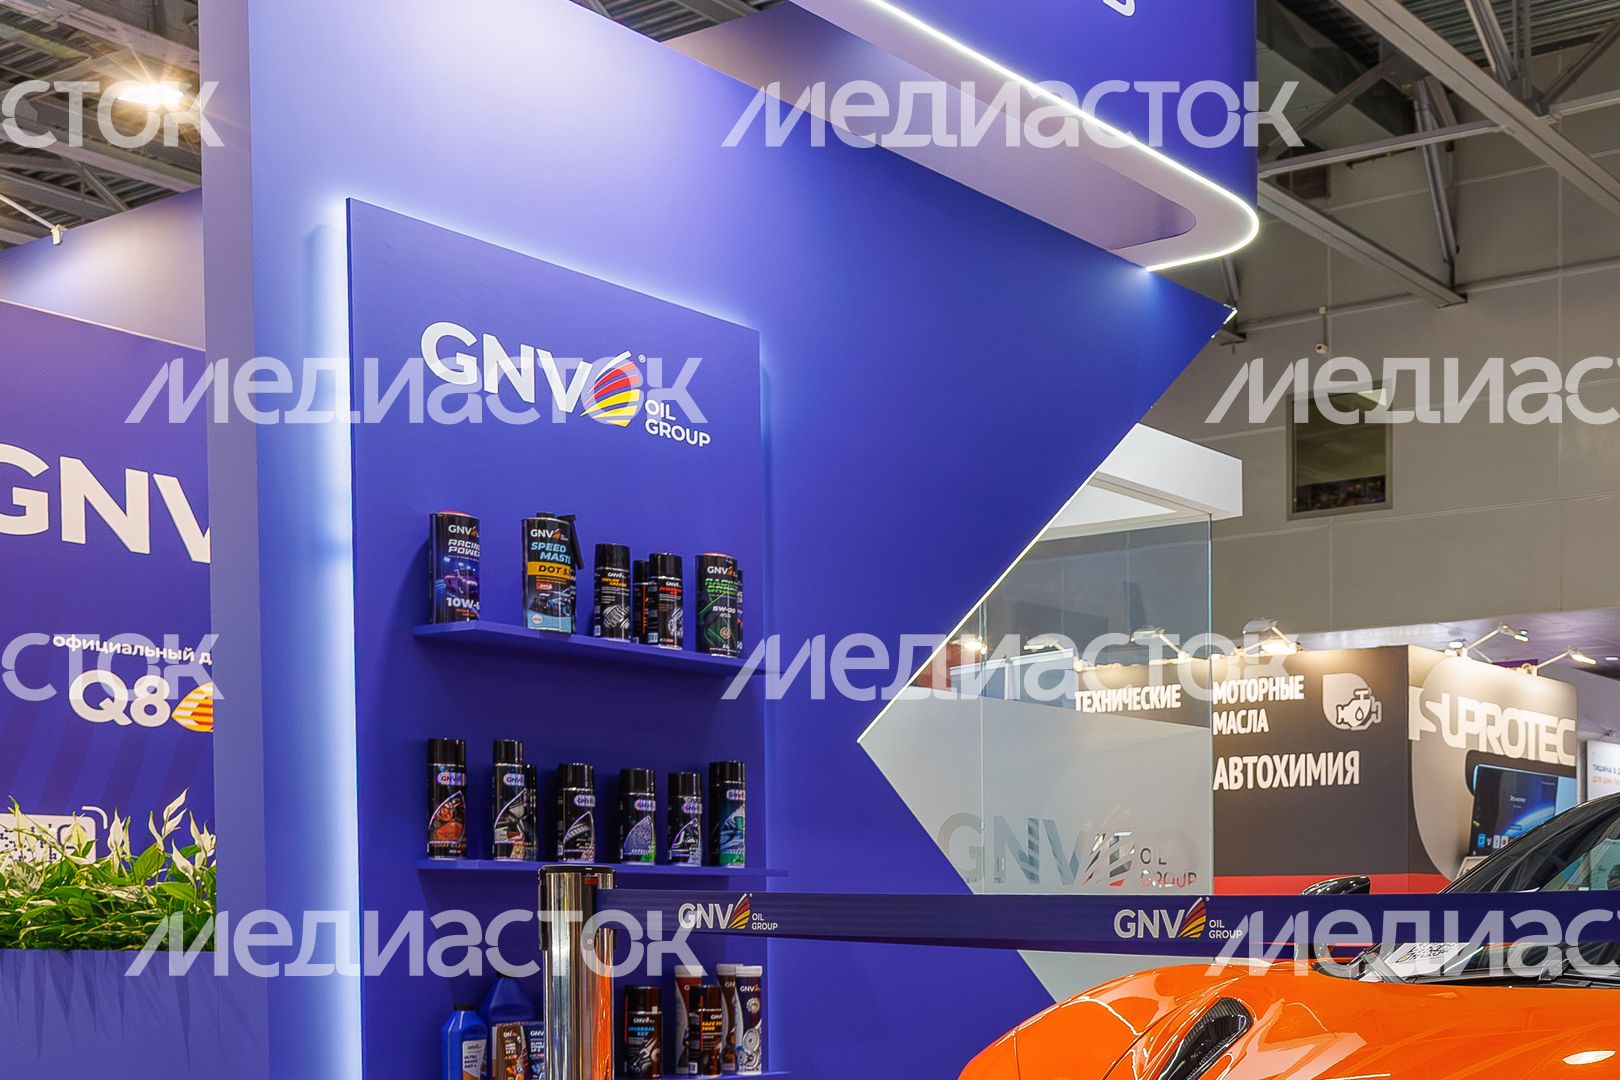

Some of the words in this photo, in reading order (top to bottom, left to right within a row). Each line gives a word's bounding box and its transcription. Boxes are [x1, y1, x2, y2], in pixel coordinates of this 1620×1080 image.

[421, 322, 593, 415] GNV
[645, 400, 676, 422] OIL
[645, 419, 711, 448] GROUP
[448, 525, 472, 536] GNV
[531, 529, 553, 538] GNV
[448, 547, 480, 558] POWE
[531, 542, 566, 552] SPEED
[538, 565, 561, 574] DOT
[707, 566, 727, 575] GNV
[446, 597, 480, 611] 10W-6
[53, 634, 195, 662] официальный
[69, 669, 171, 727] Q8
[1074, 684, 1182, 713] ТЕХНИЧЕСКИЕ
[1213, 675, 1304, 705] МОТОРНЫЕ
[1213, 708, 1269, 735] МАСЛА
[1213, 751, 1360, 791] АВТОХИМИЯ
[678, 903, 733, 929] GNV
[752, 913, 764, 921] OIL
[1114, 909, 1185, 939] GNV
[1209, 920, 1225, 929] OIL
[751, 922, 778, 930] GROUP
[1208, 930, 1243, 939] GROUP
